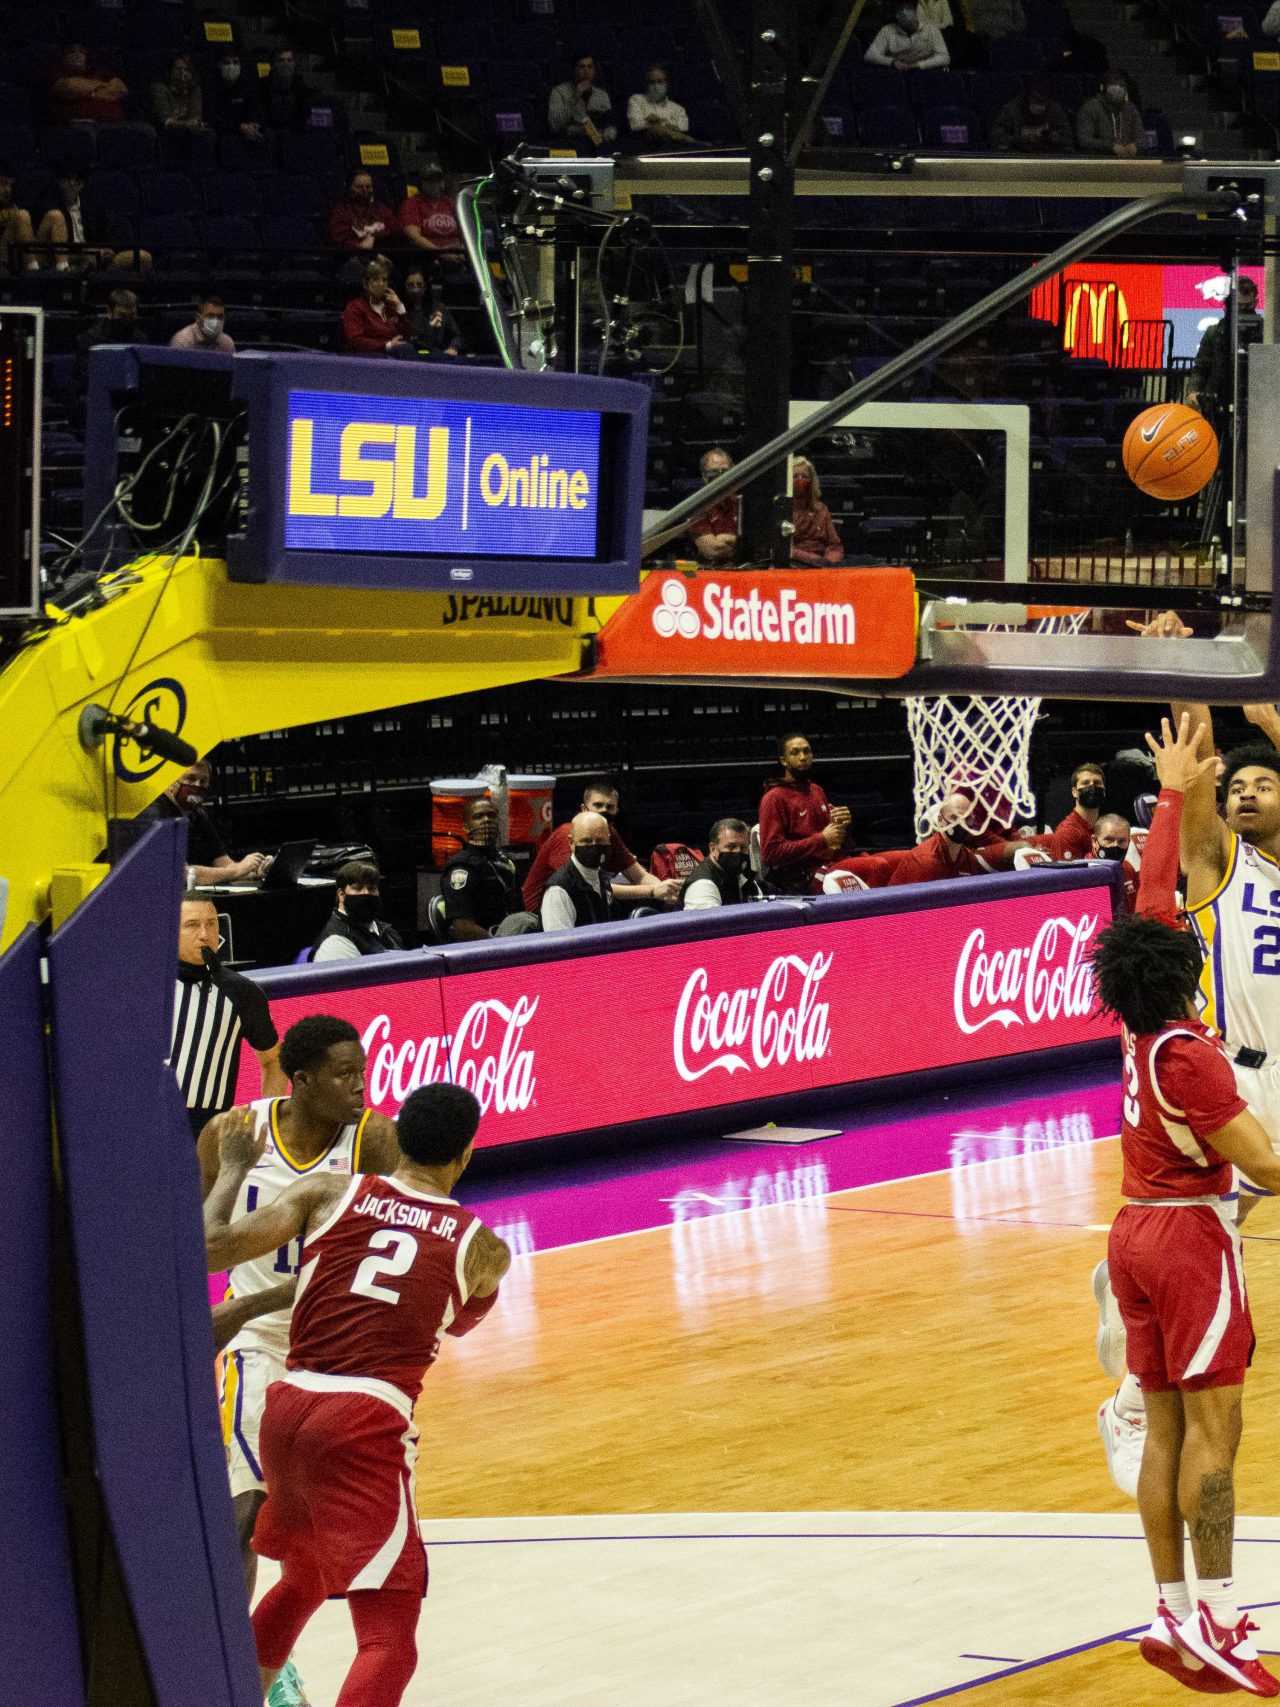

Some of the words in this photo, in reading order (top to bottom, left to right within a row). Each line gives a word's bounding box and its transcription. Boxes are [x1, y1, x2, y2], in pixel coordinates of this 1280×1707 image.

[287, 418, 450, 520] LSU
[480, 453, 590, 510] Online
[703, 583, 856, 645] StateFarm
[673, 951, 834, 1082] Coca-Cola
[953, 914, 1099, 1034] Coca-Cola
[353, 1193, 433, 1231] JACKSON
[432, 1214, 458, 1242] JR.
[350, 1229, 418, 1305] 2
